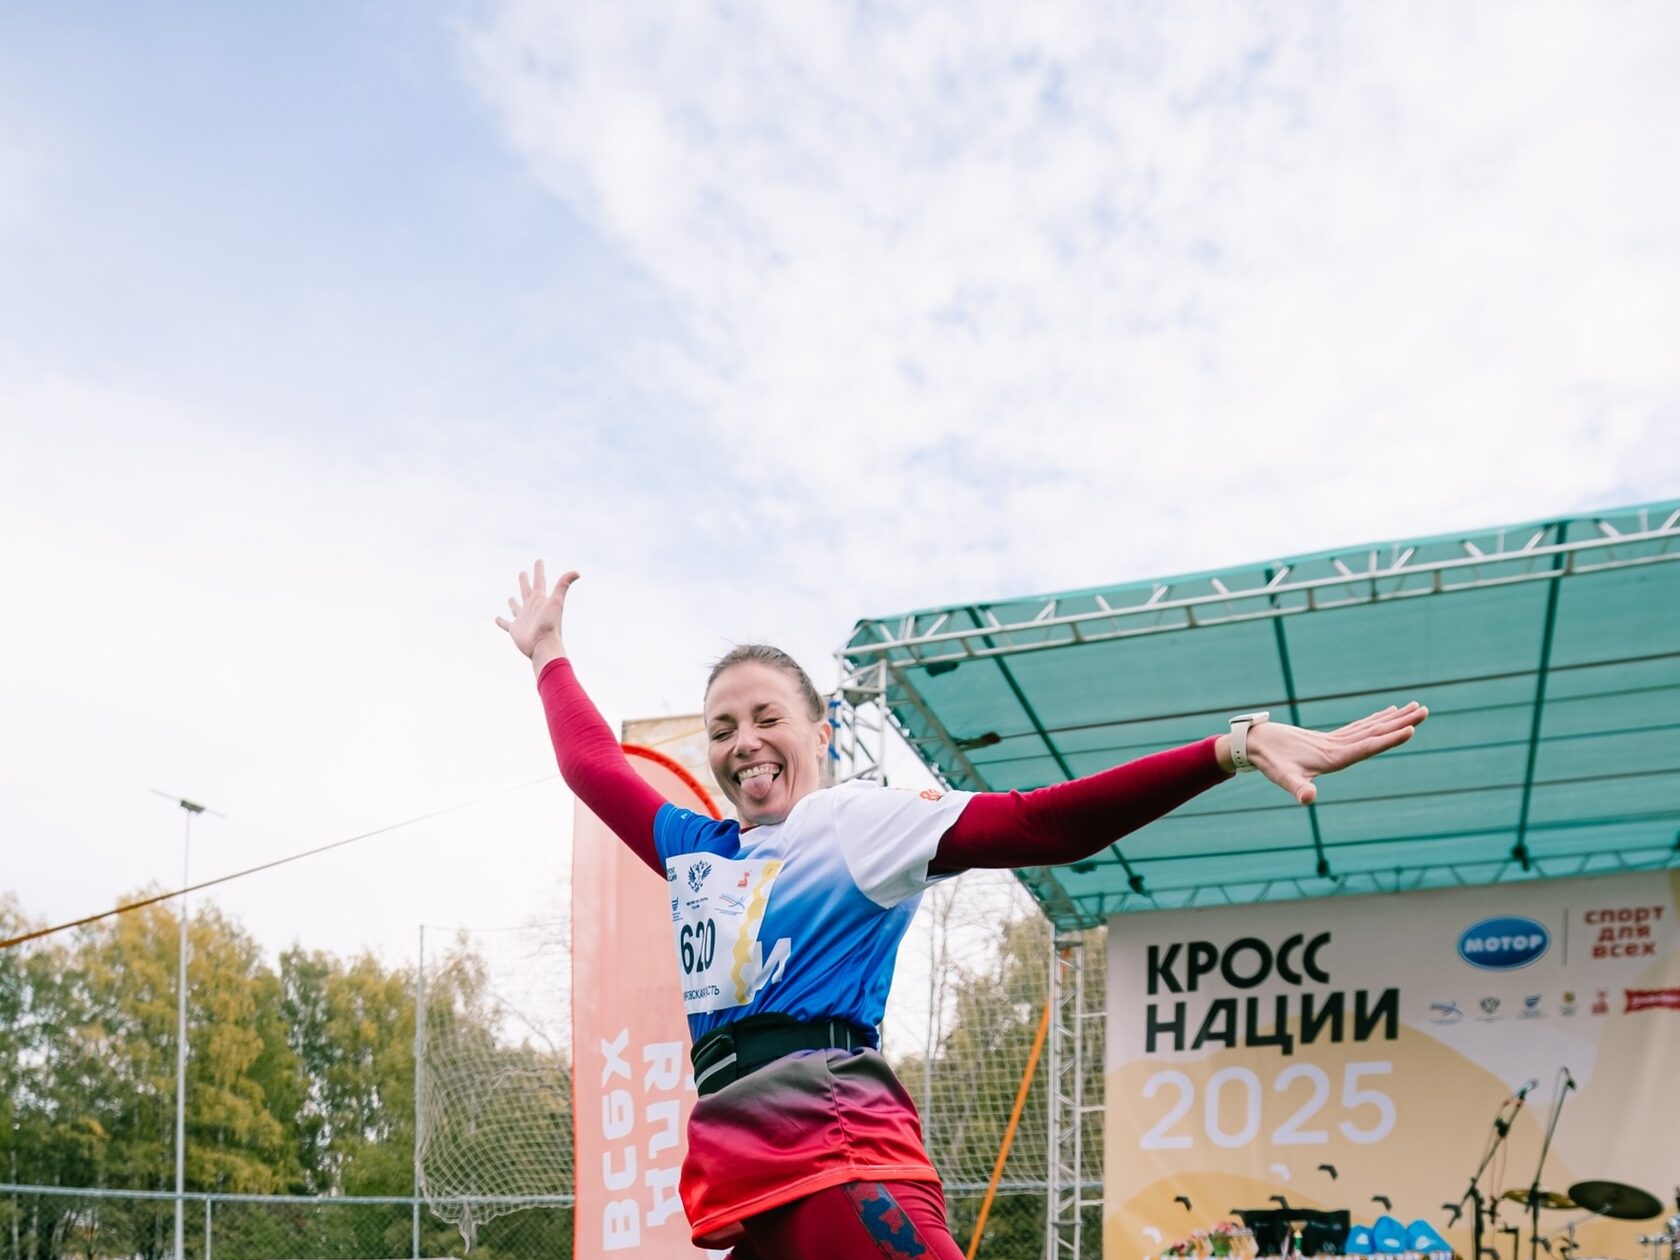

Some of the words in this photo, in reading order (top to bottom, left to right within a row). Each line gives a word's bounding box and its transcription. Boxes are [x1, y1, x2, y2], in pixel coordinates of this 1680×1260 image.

[680, 918, 716, 975] 620
[1147, 931, 1331, 995] КРОСС
[1465, 934, 1543, 953] МОТОР
[1146, 988, 1399, 1056] НАЦИИ
[1140, 1061, 1397, 1150] 2025
